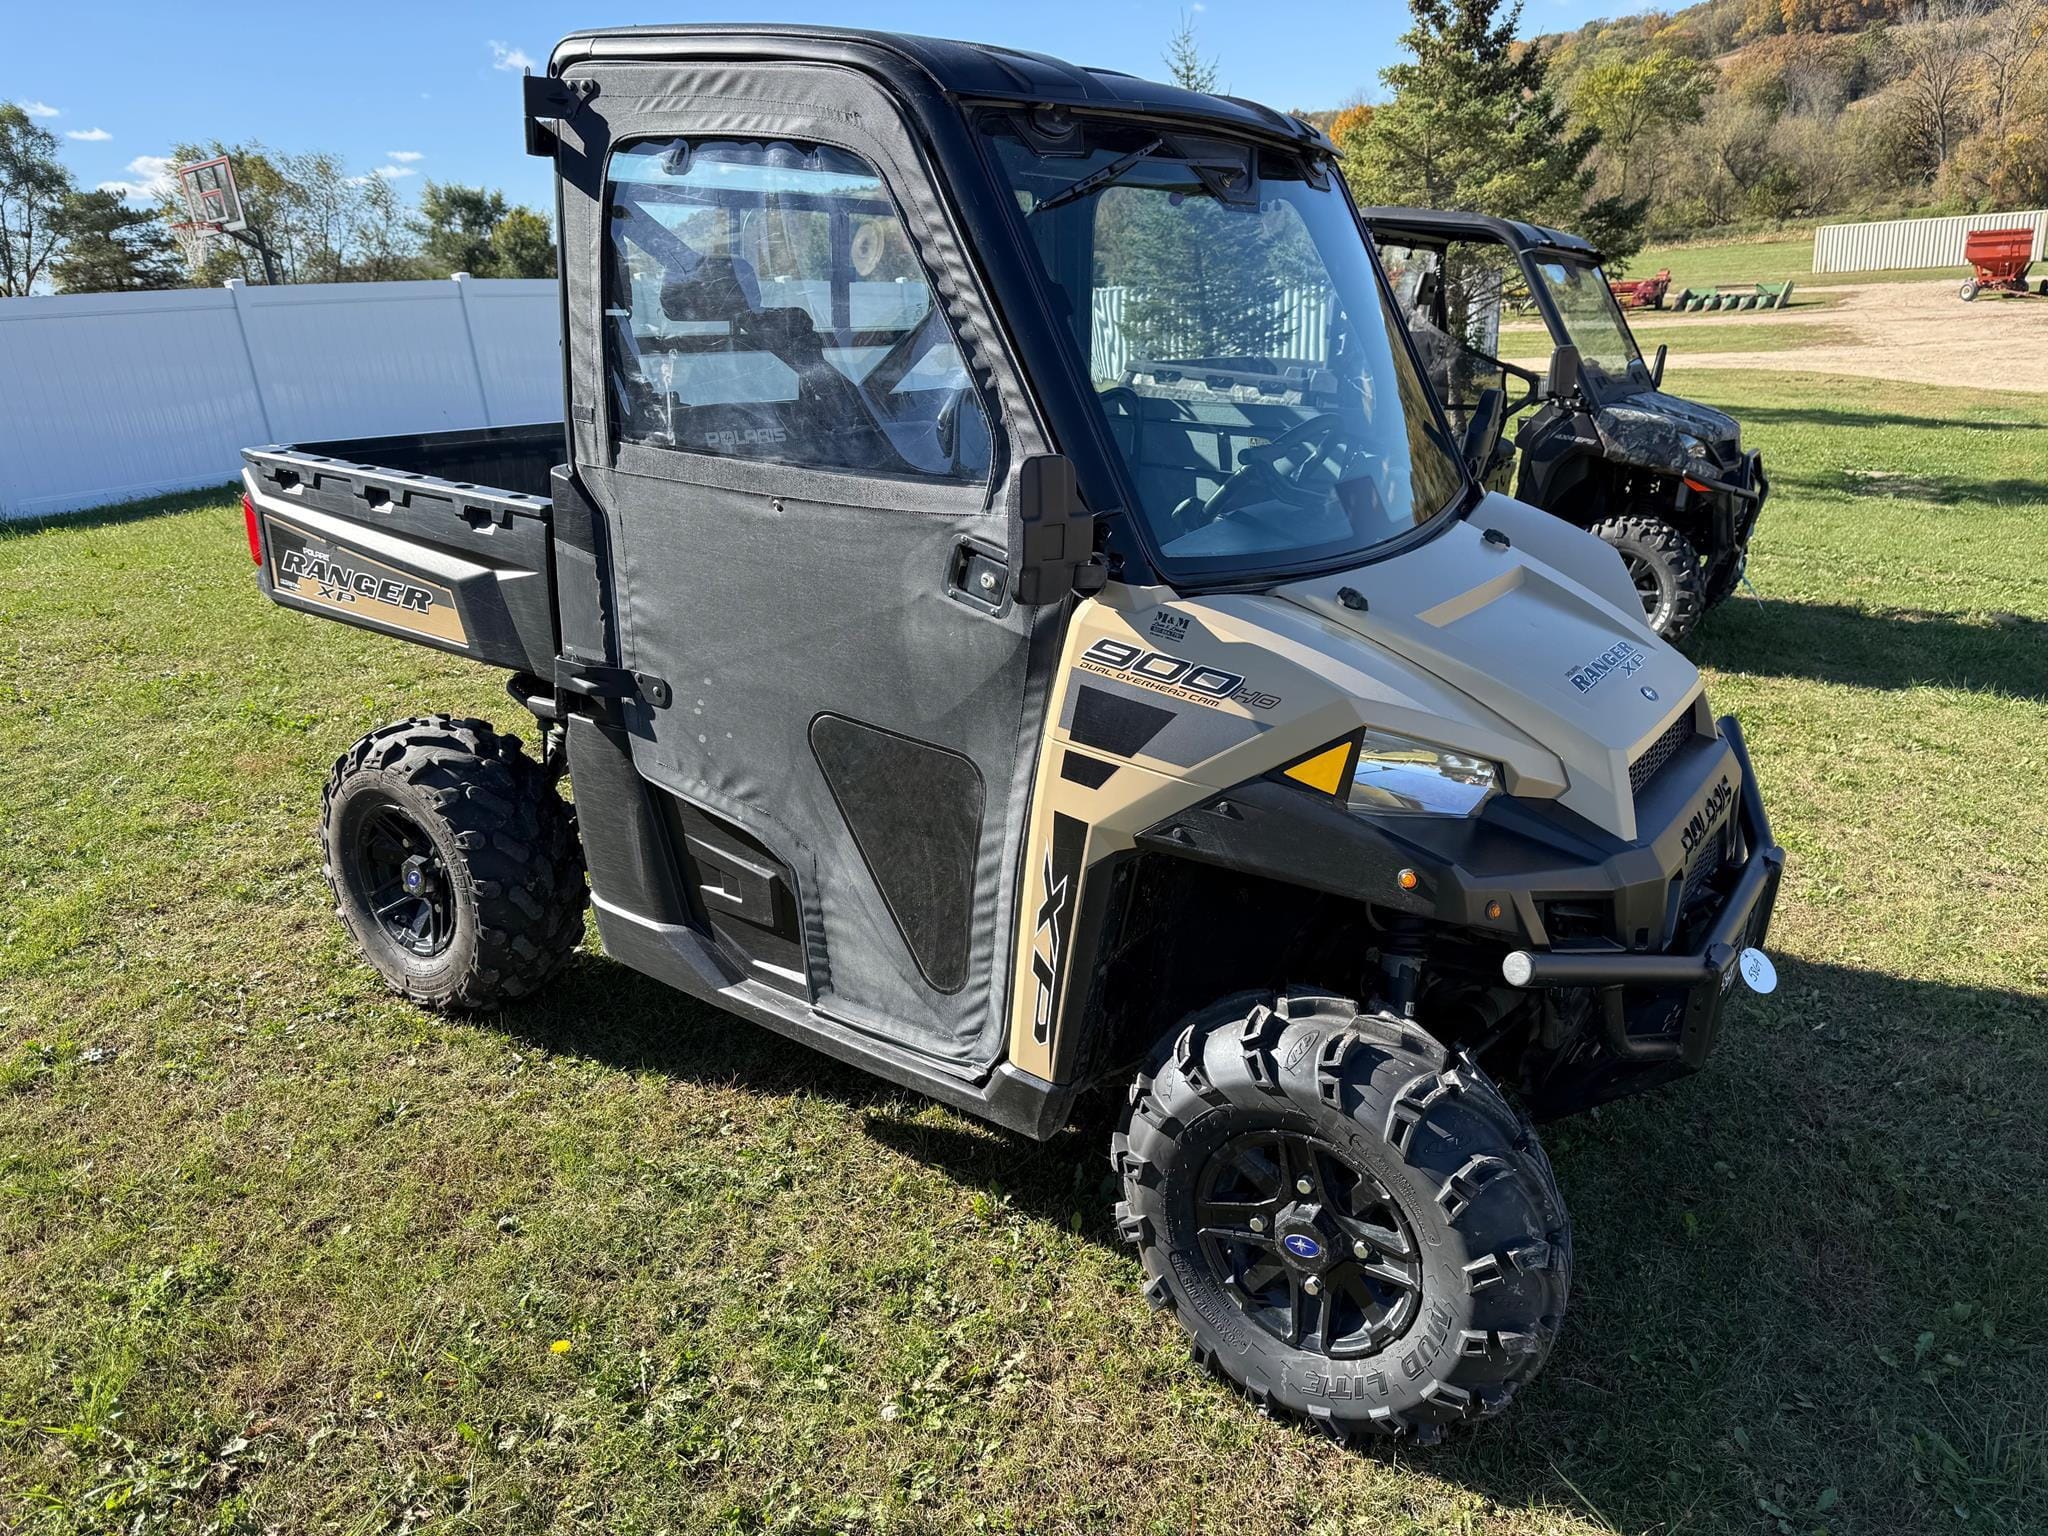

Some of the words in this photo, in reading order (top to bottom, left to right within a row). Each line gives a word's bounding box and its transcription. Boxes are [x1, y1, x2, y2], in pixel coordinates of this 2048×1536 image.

[704, 427, 787, 447] POLARIS
[281, 550, 433, 614] RANGER
[315, 584, 356, 603] XP
[1080, 661, 1112, 677] DUAL
[1115, 674, 1187, 698] OVERHEAD
[1188, 692, 1220, 708] CAM
[1081, 639, 1245, 700] 900
[1231, 687, 1282, 710] HO
[1569, 640, 1638, 694] RANGER
[1619, 653, 1646, 679] XP
[1031, 834, 1068, 1047] XP
[1401, 1300, 1453, 1381] MUD
[1302, 1370, 1389, 1400] LITE
